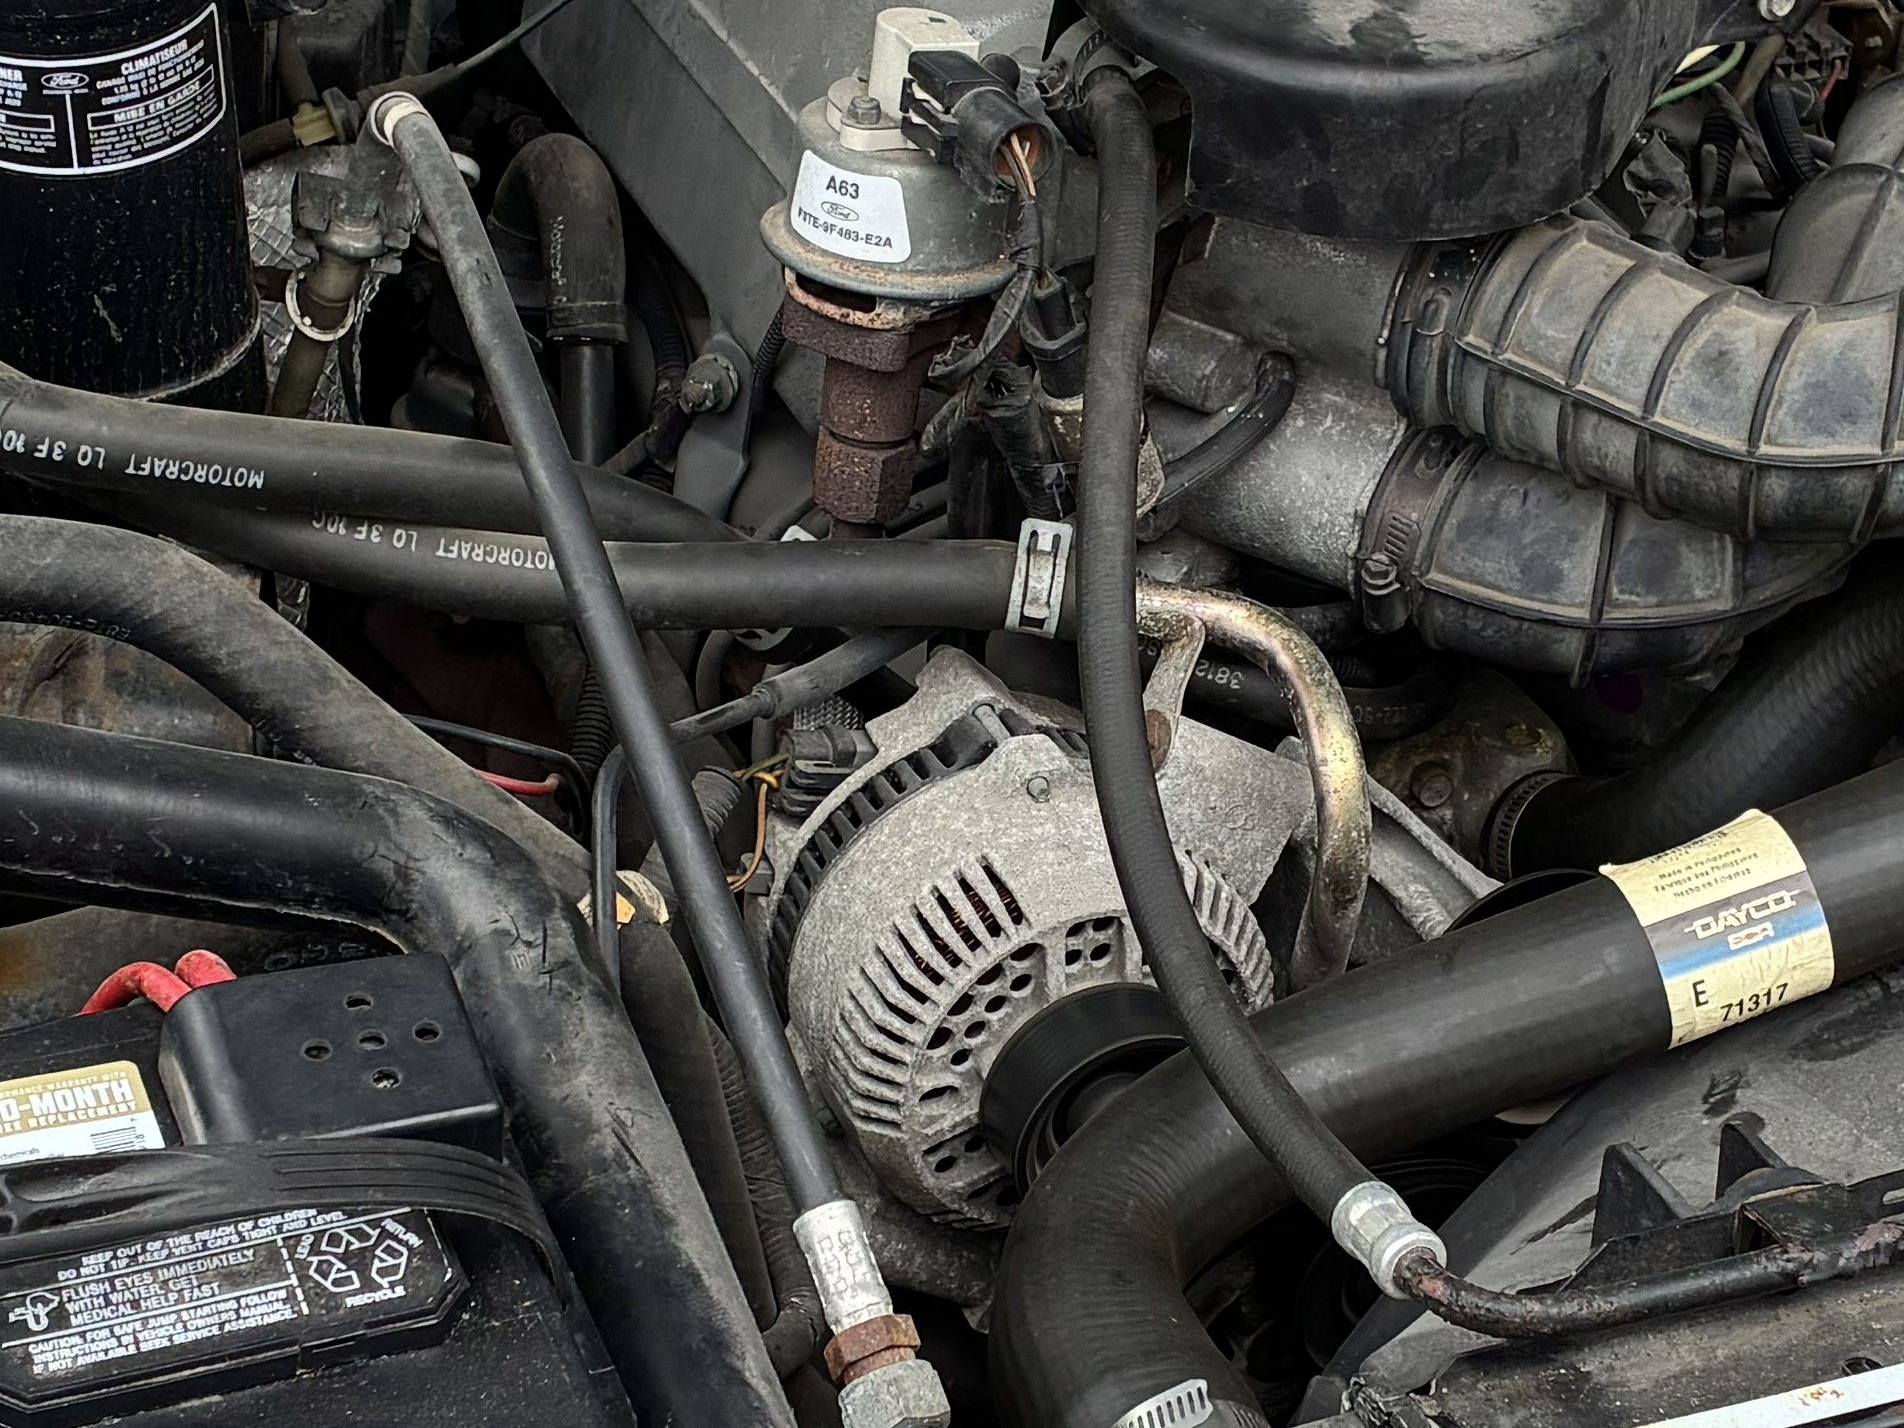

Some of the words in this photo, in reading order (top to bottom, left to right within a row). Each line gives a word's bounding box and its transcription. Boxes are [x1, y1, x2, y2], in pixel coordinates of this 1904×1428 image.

[825, 175, 860, 200] A63
[124, 451, 265, 491] MOTORCRAFT
[1686, 889, 1799, 939] DAYCO
[1692, 979, 1709, 1008] E
[1720, 982, 1790, 1022] 71317
[61, 1280, 111, 1303] FLUSH
[114, 1270, 153, 1291] EYES
[157, 1247, 256, 1281] IMMEDIATELY
[65, 1294, 105, 1314] WITH
[168, 1273, 199, 1292] GET
[69, 1301, 136, 1327] MEDICAL
[139, 1291, 179, 1311] HELP
[182, 1282, 221, 1301] FAST
[345, 1284, 407, 1308] RECYCLE
